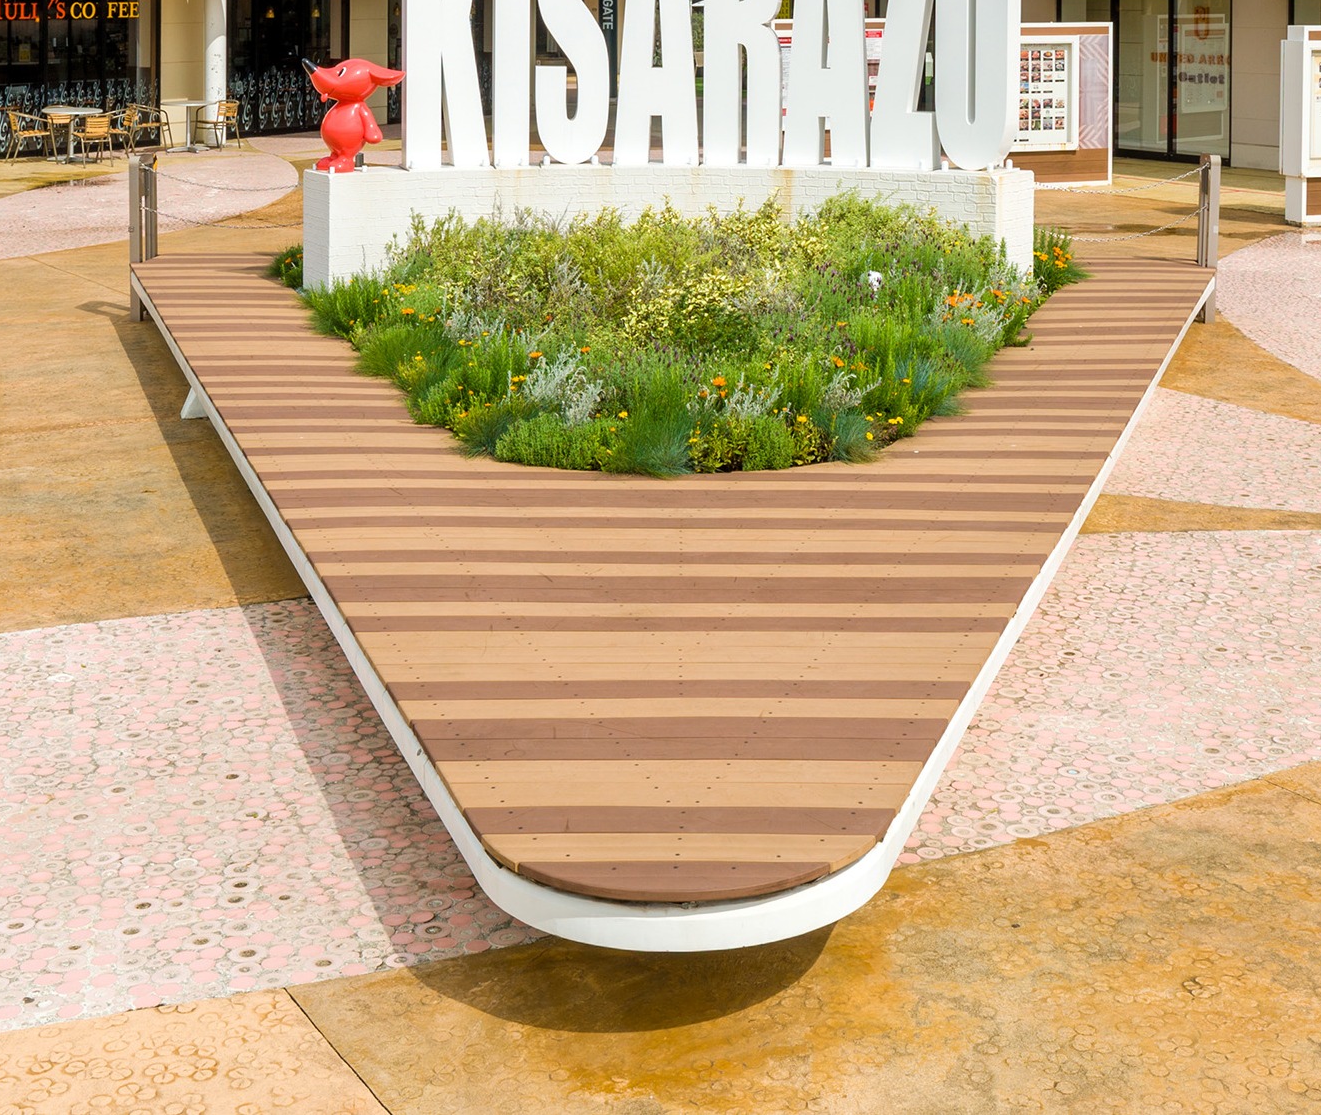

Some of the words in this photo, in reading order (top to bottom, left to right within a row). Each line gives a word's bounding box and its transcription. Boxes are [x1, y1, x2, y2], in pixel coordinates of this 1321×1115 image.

[70, 1, 140, 19] COFEE
[1150, 52, 1195, 64] UNTED
[1178, 71, 1225, 84] Outlet
